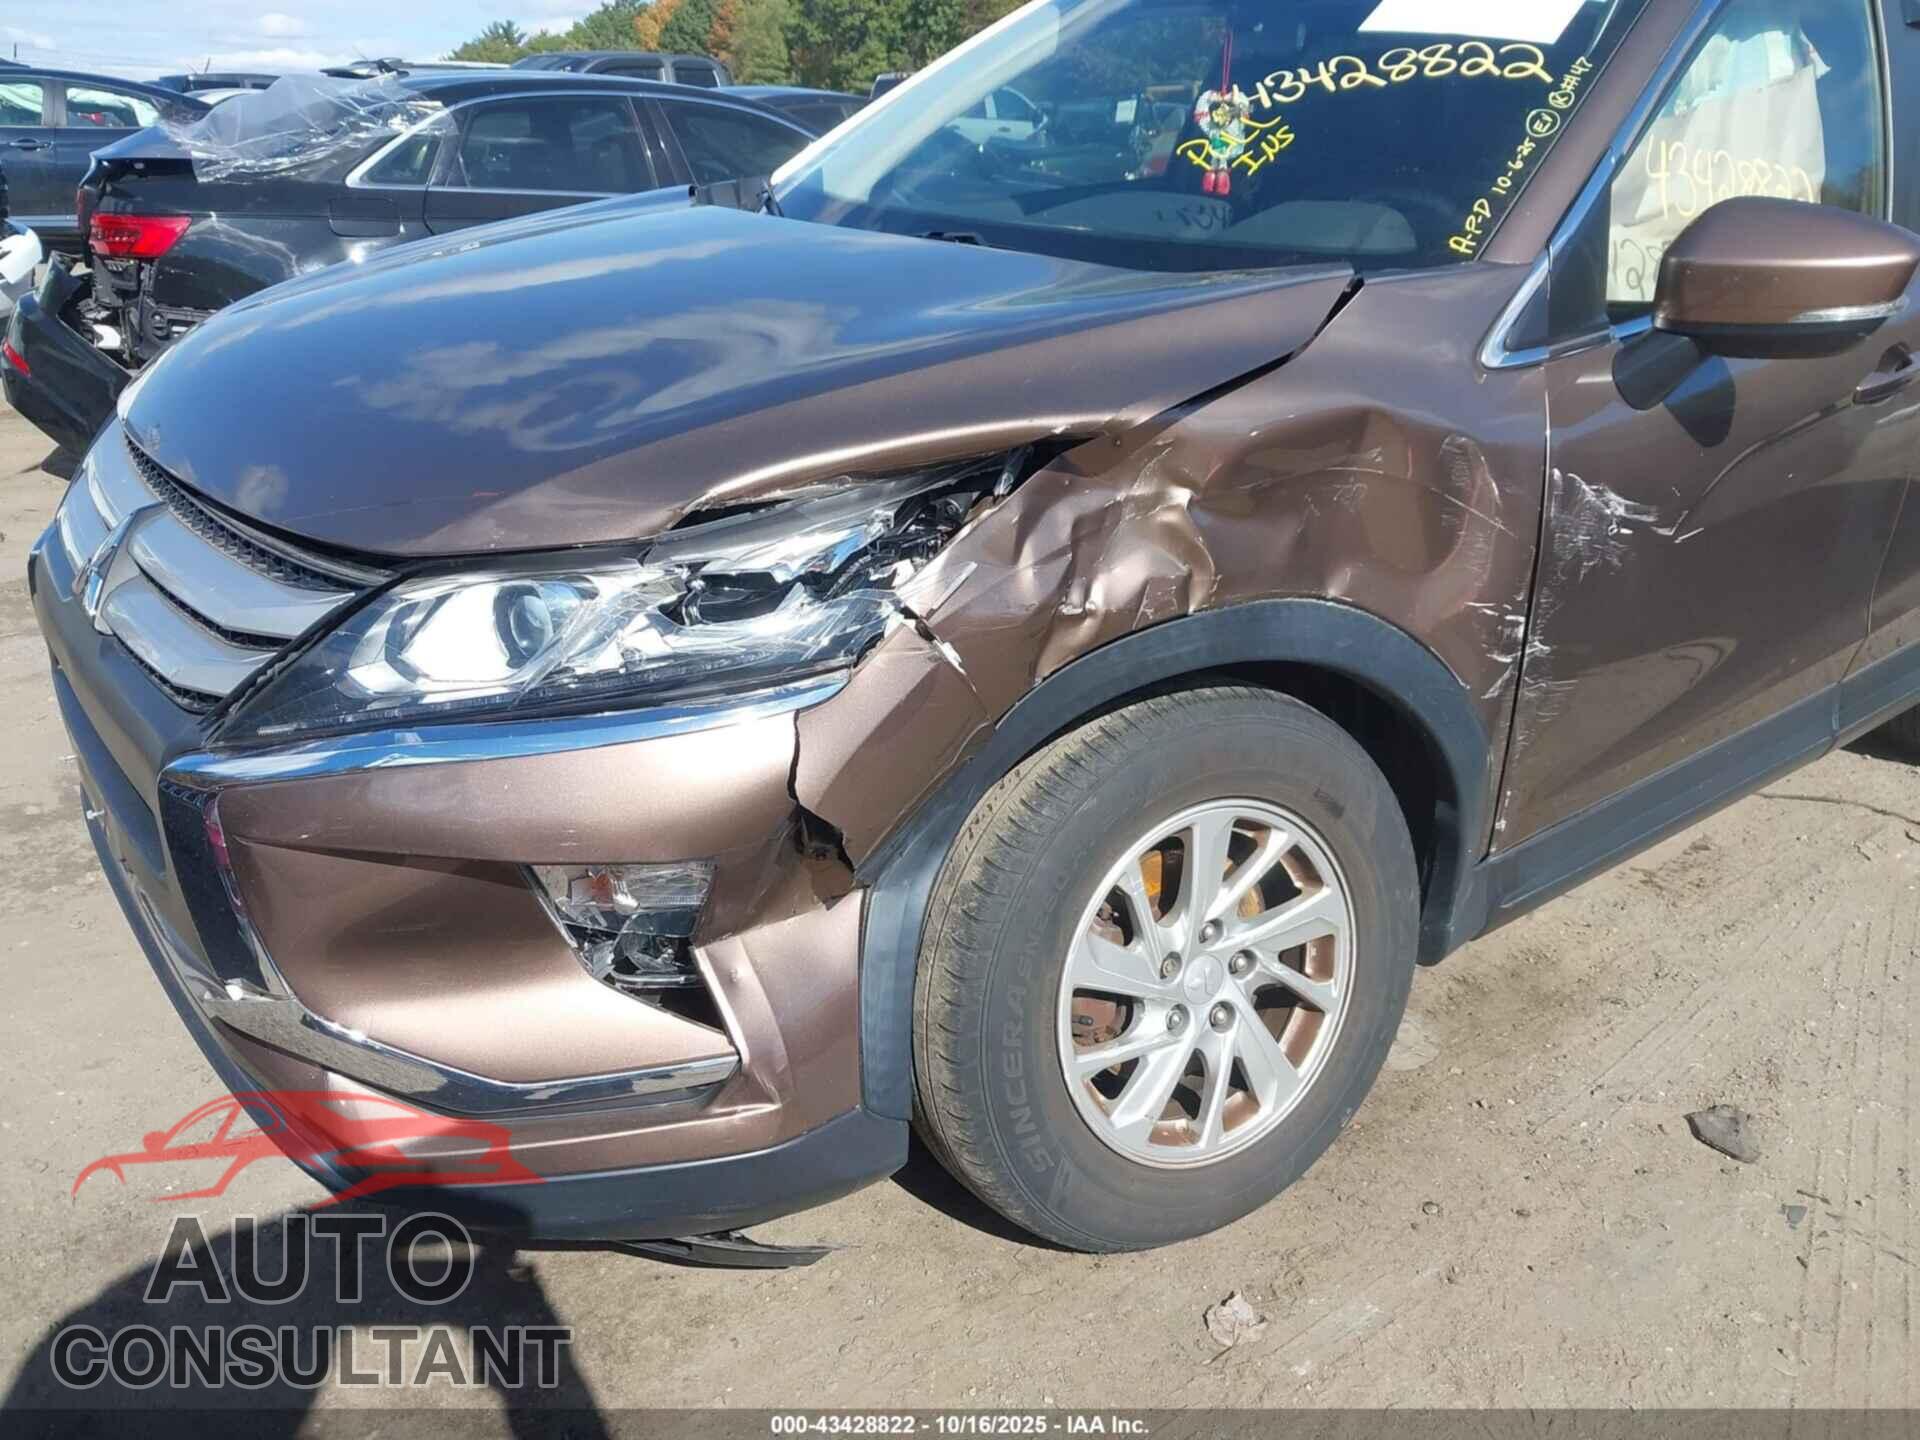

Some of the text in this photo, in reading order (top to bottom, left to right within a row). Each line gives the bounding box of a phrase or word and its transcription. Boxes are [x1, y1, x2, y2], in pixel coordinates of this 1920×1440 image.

[1233, 42, 1553, 109] 43428822
[1232, 125, 1295, 176] INS
[1003, 986, 1049, 1173] SINCERA
